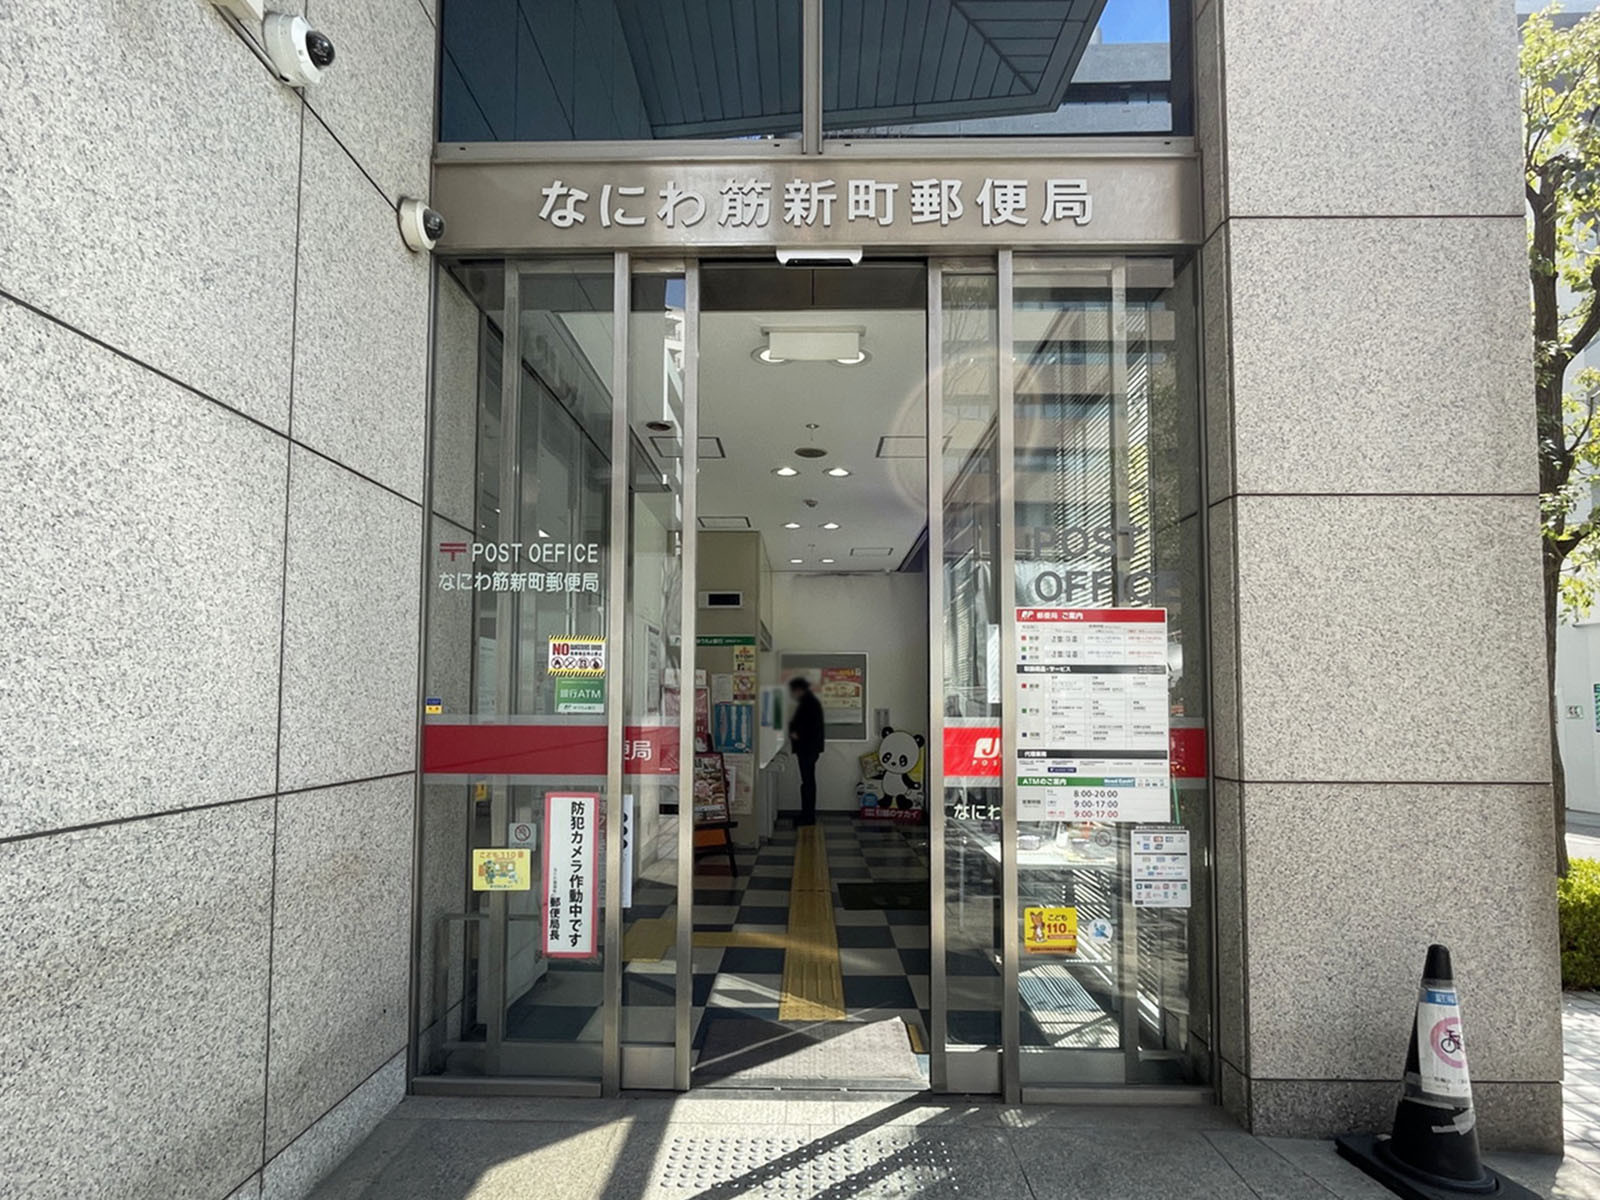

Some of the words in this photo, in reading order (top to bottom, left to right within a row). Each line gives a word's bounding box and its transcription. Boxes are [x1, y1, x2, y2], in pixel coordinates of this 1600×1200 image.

[538, 178, 1094, 228] なにわ筋新町郵便局
[471, 543, 523, 563] POST
[438, 572, 599, 593] なにわ筋新町郵便局
[552, 643, 570, 656] NO
[568, 801, 585, 947] 防犯カメラ作動中です
[549, 896, 561, 940] 郵便局長
[1047, 922, 1067, 933] 110
